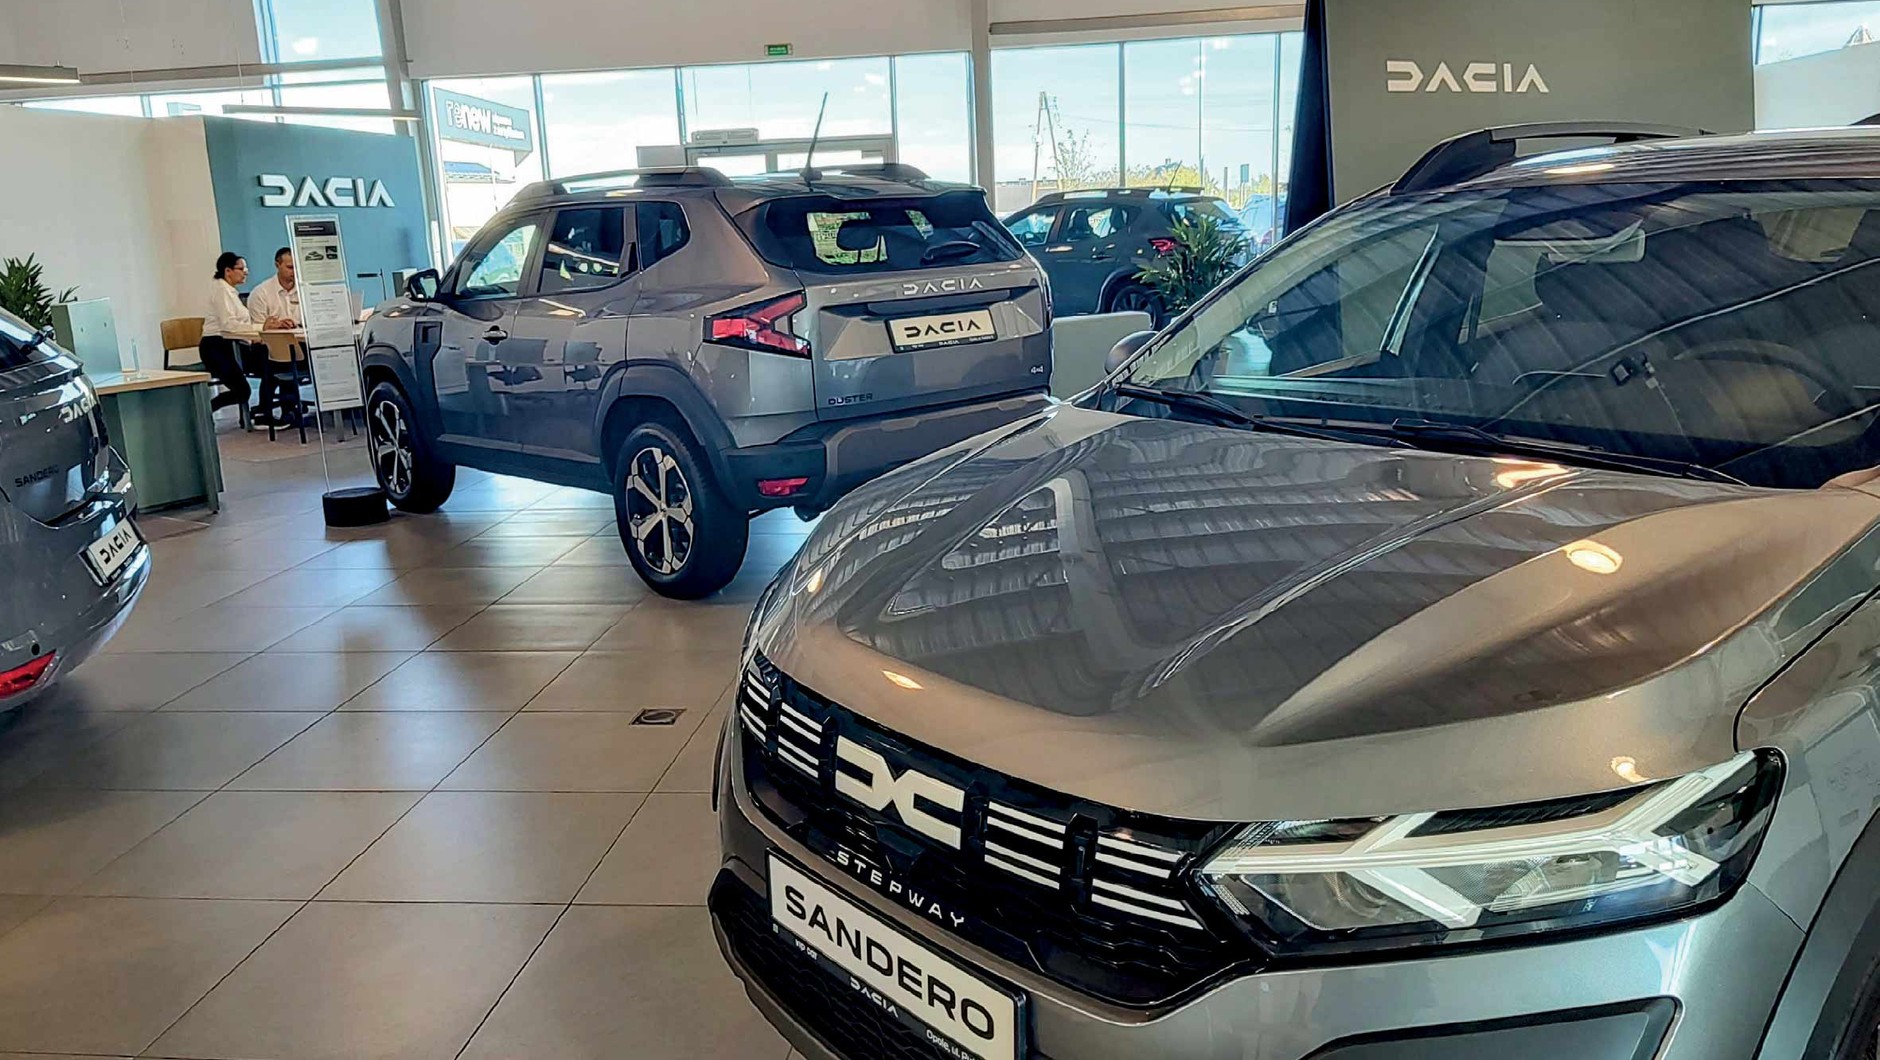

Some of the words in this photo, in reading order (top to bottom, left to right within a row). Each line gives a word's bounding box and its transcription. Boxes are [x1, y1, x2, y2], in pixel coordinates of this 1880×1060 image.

[1386, 60, 1549, 93] DACIA
[445, 100, 492, 134] renew
[258, 173, 396, 207] DACIA
[902, 278, 983, 296] DACIA
[904, 320, 981, 338] DACIA
[828, 393, 873, 405] DUSTER
[99, 527, 133, 565] DACIA
[836, 850, 965, 928] STEPWAY
[785, 884, 995, 1041] SANDERO
[849, 976, 899, 1018] DACIA
[926, 1029, 951, 1053] Opole,
